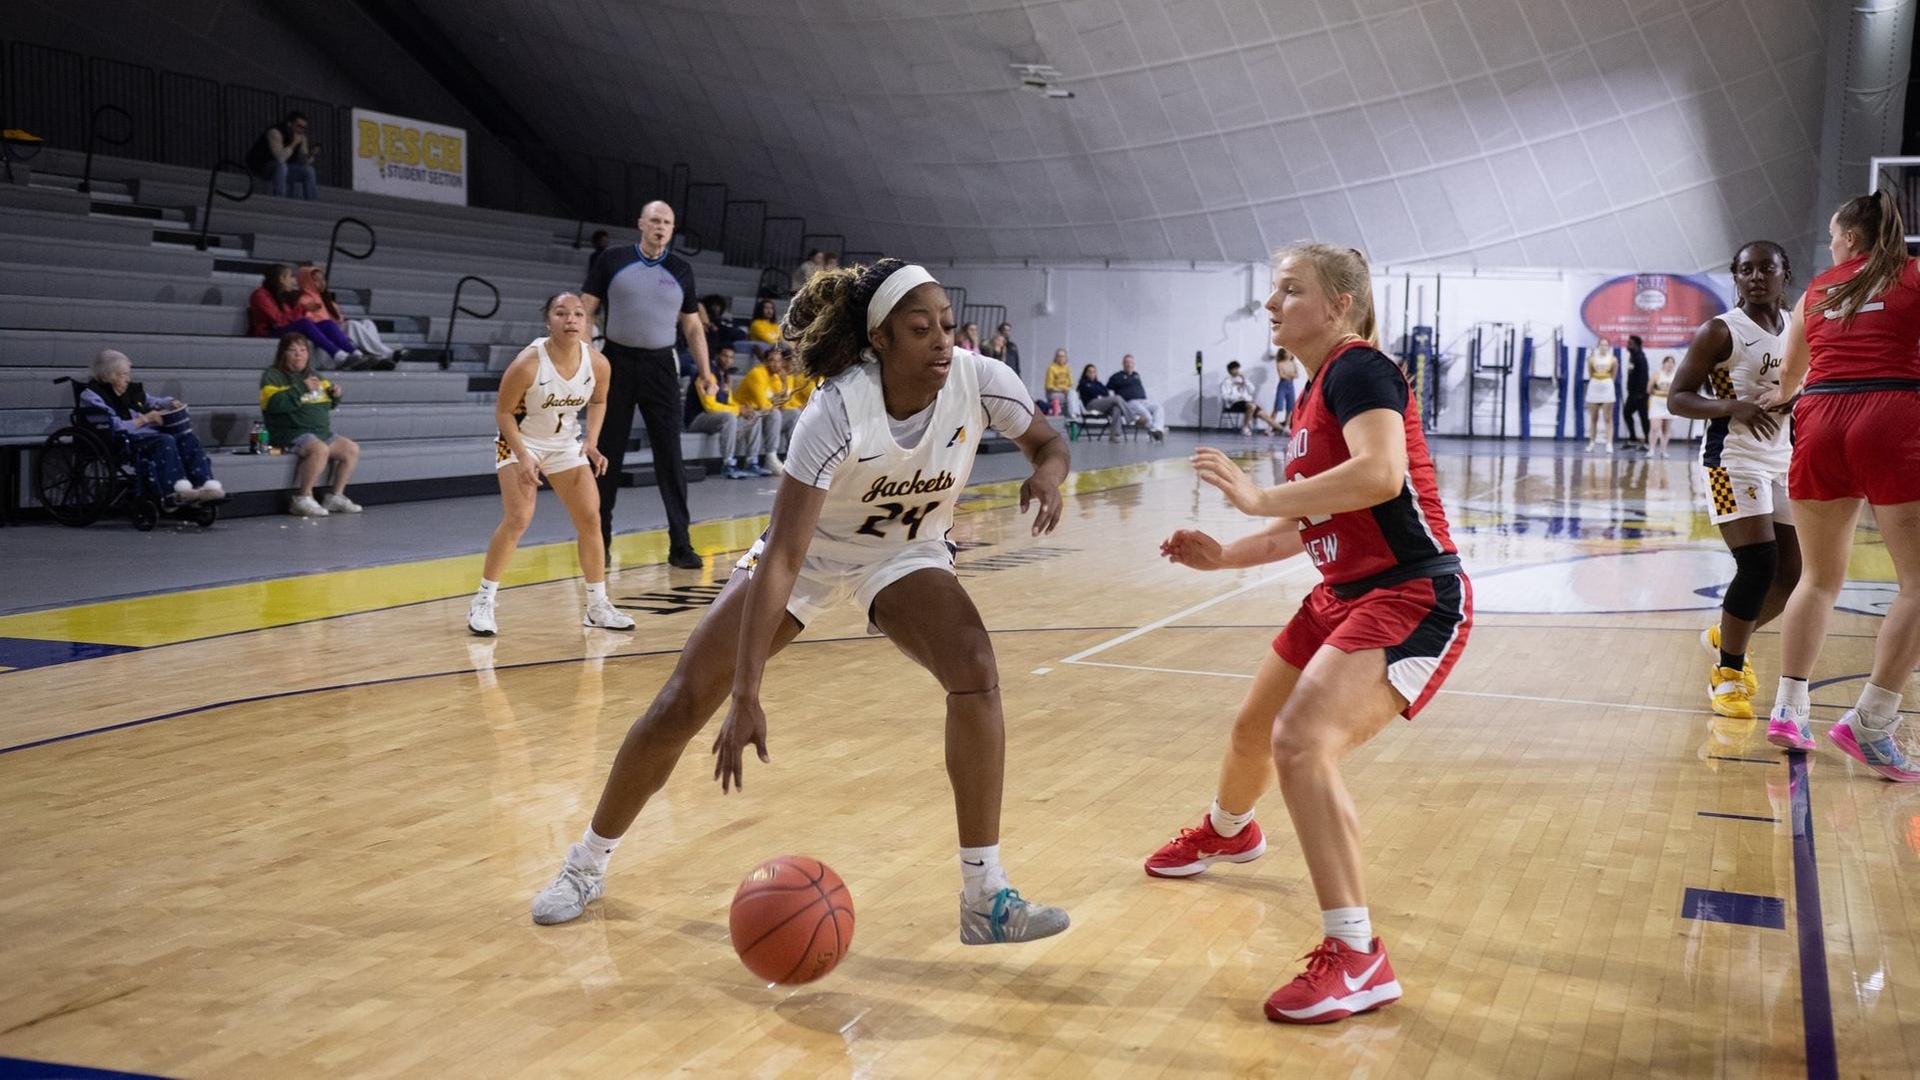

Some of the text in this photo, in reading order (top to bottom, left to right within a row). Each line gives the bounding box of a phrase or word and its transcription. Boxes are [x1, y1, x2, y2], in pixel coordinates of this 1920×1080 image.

[387, 164, 463, 188] STUDENT SECTION
[541, 393, 585, 409] Jackets
[554, 413, 565, 433] 1
[861, 469, 956, 502] Jackets
[856, 501, 943, 541] 24
